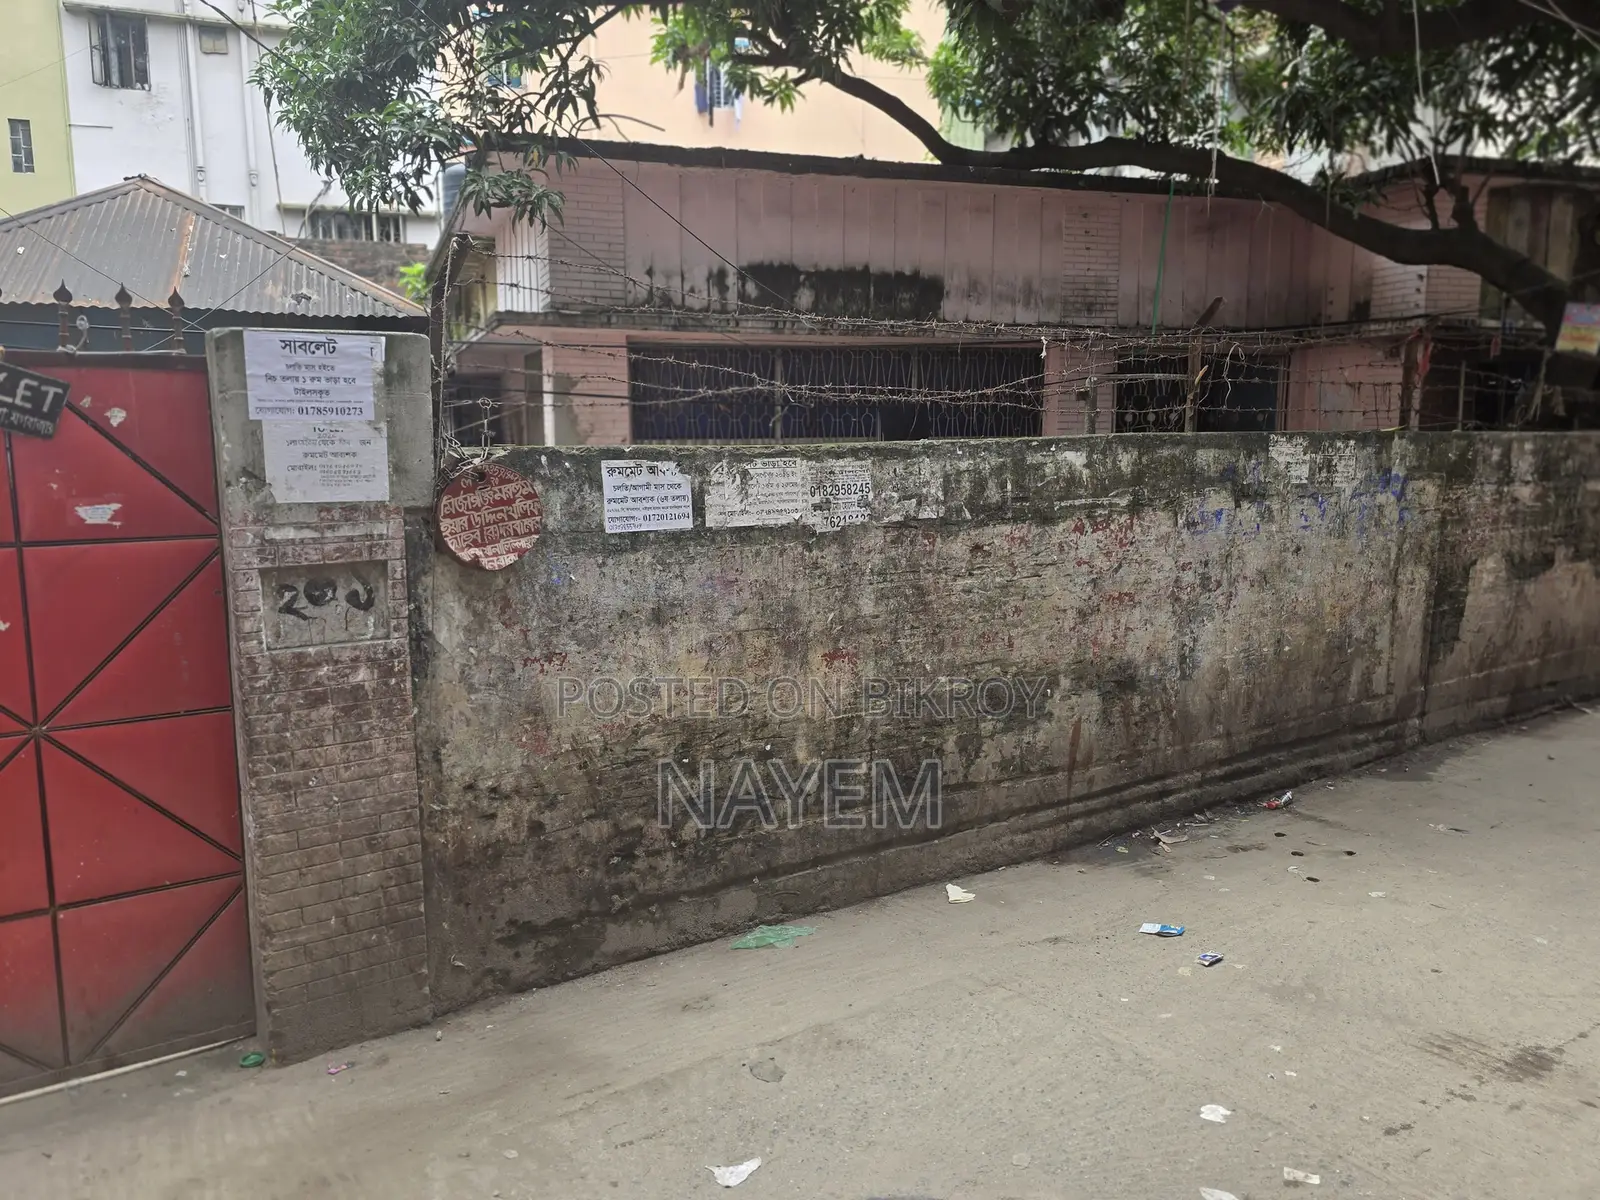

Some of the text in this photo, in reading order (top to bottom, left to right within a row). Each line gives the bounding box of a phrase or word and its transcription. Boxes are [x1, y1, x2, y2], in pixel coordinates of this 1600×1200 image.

[279, 336, 338, 356] সাবলেট
[297, 405, 364, 417] 01785910273
[653, 483, 666, 491] মাস
[810, 482, 871, 498] 0182958245
[642, 512, 690, 522] 01720121694
